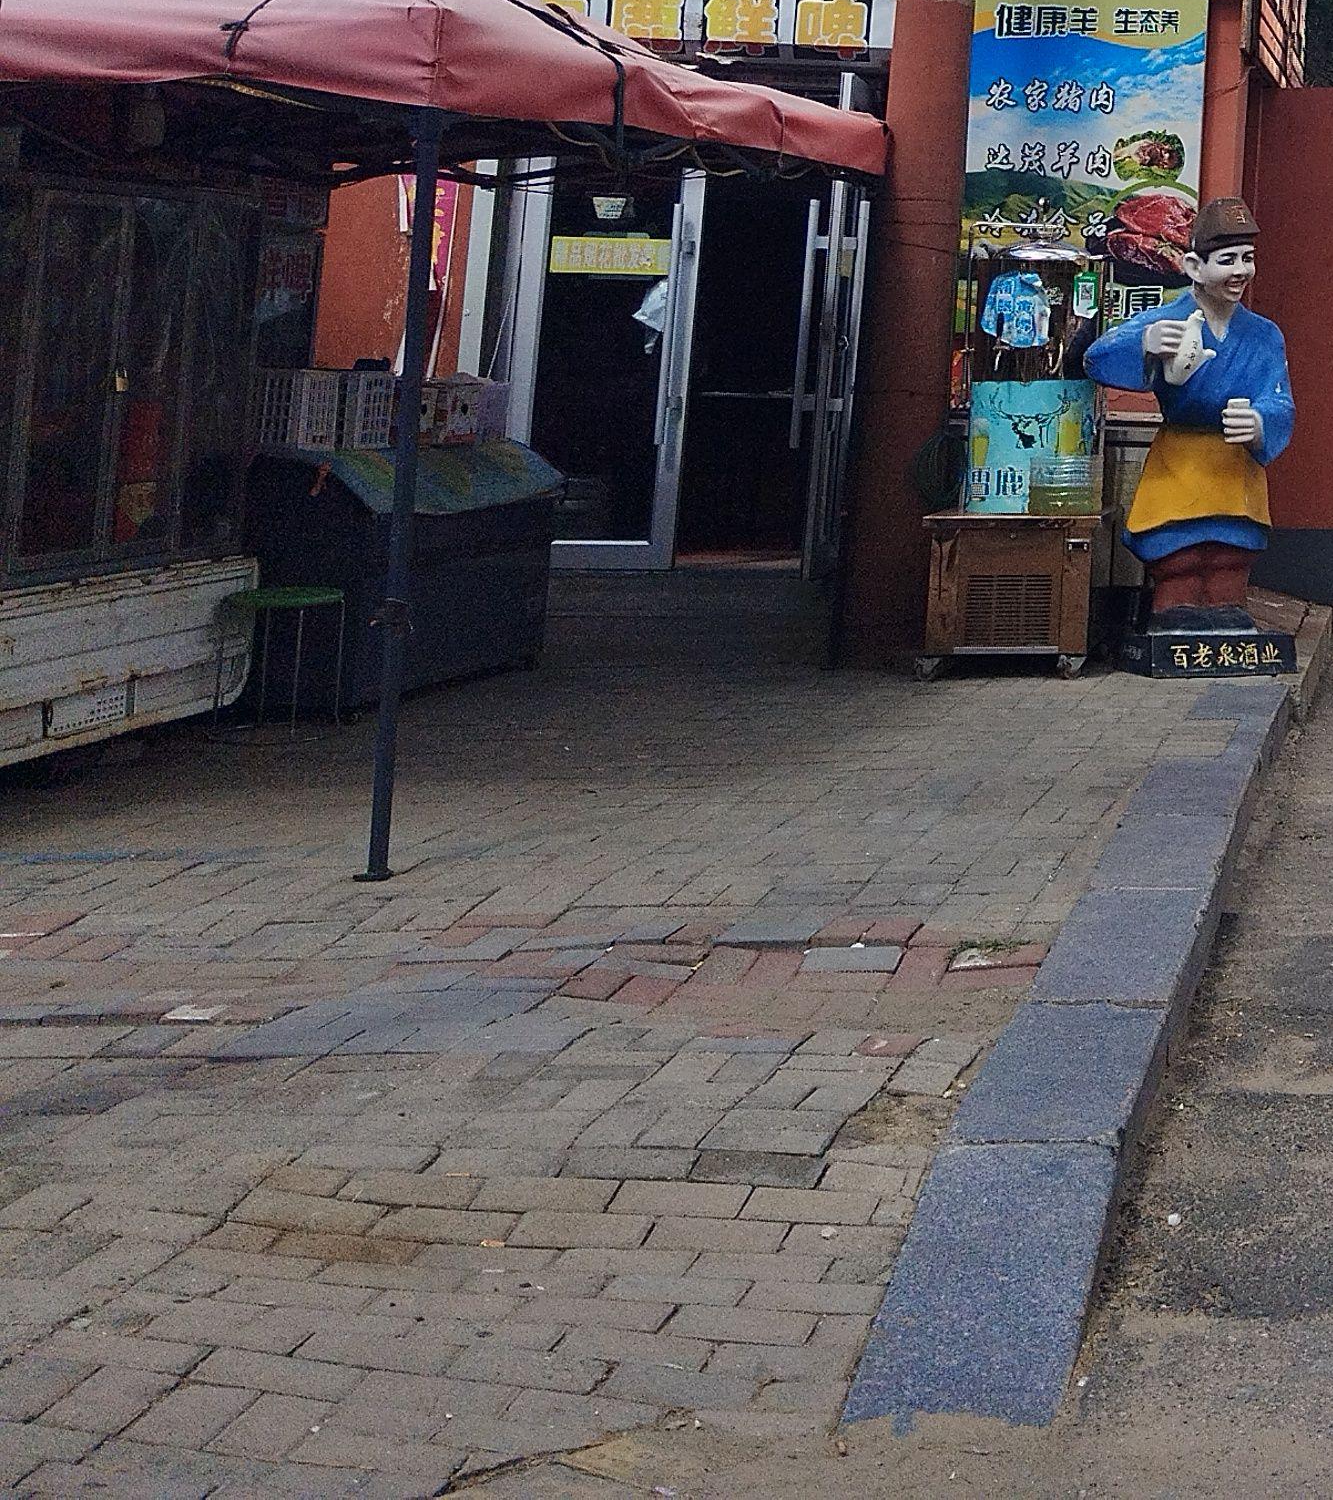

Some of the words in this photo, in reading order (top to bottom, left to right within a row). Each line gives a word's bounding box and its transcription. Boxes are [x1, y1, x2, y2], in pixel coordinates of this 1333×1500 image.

[995, 2, 1099, 39] 健康羊
[1113, 7, 1180, 35] 生态养
[985, 76, 1116, 114] 农家猪肉
[984, 140, 1114, 179] 达茂羊肉
[1170, 642, 1283, 669] 百老泉酒业
